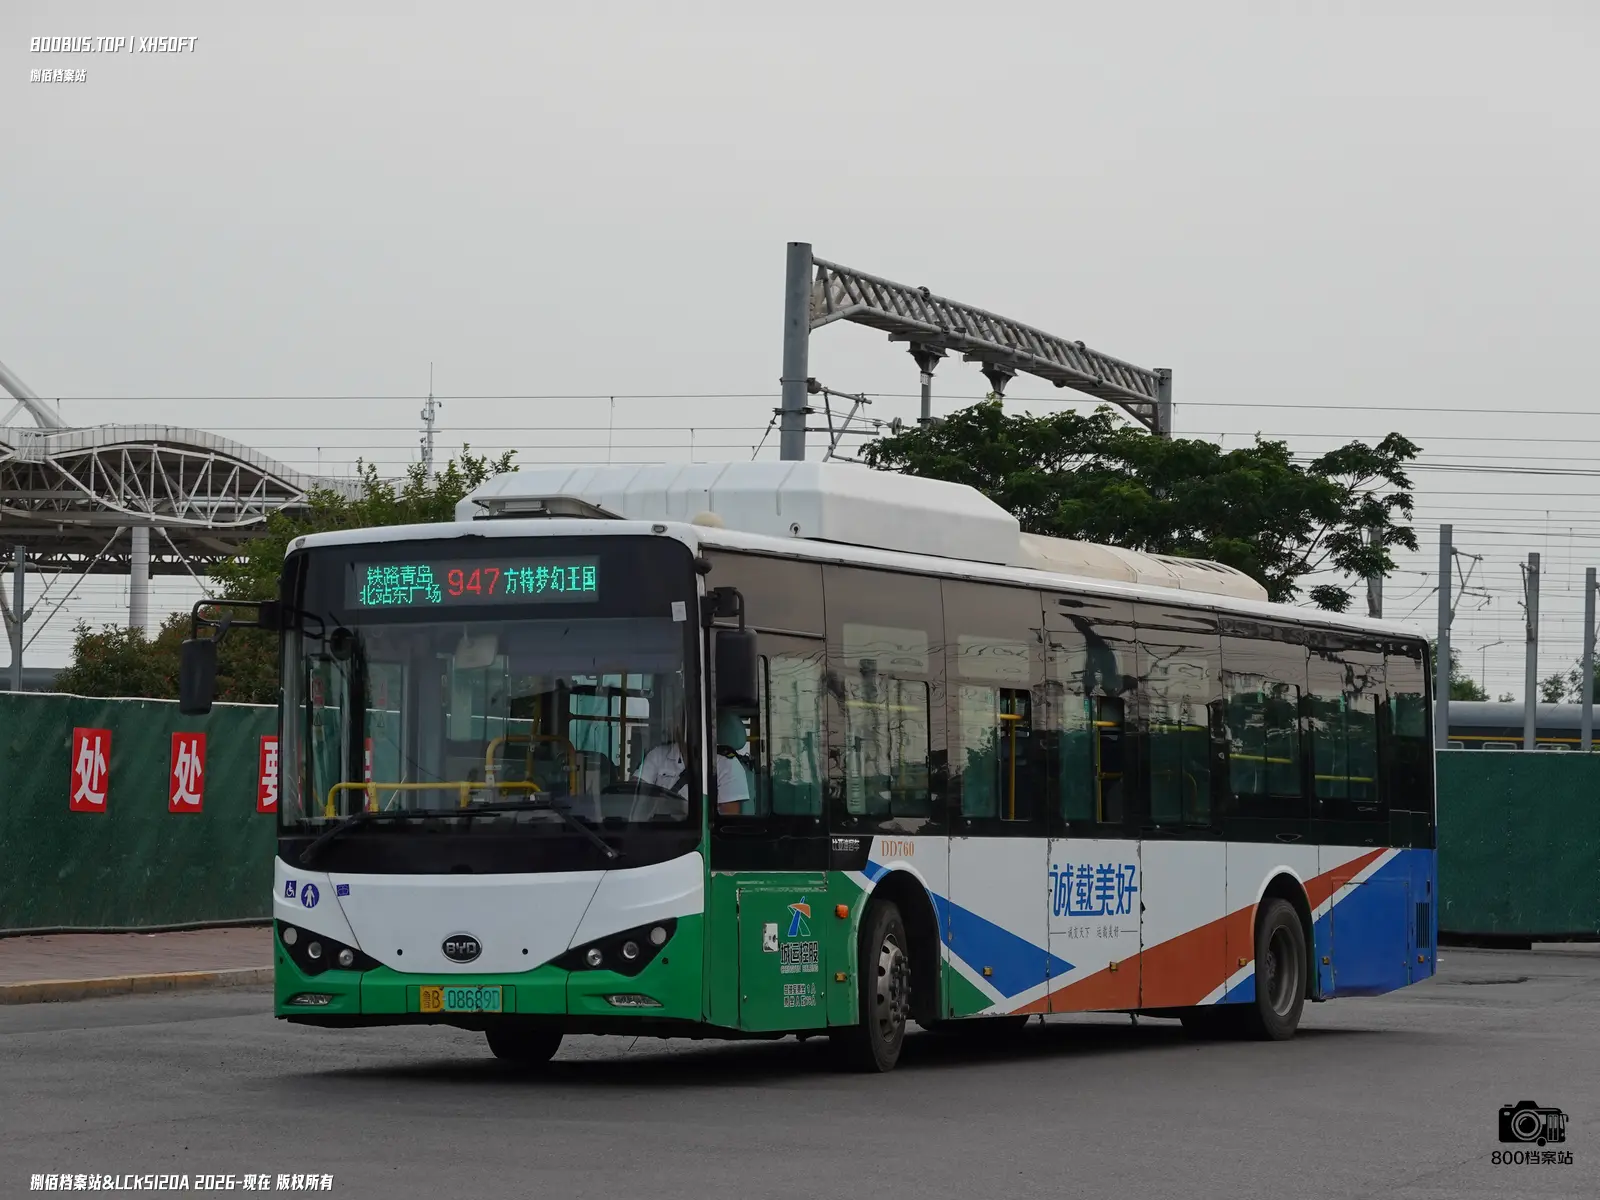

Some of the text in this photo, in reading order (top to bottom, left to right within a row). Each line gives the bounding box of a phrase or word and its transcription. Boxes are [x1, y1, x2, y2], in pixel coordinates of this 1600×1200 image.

[367, 565, 433, 586] 铁路青岛
[448, 568, 500, 596] 947
[504, 566, 596, 594] 方特梦幻王国
[359, 584, 442, 605] 北站东广场
[74, 736, 106, 804] 处
[172, 739, 202, 805] 处
[881, 840, 915, 857] DD760
[1049, 863, 1138, 916] 诚载美好
[446, 942, 476, 954] BYD
[780, 941, 819, 964] 城运控股
